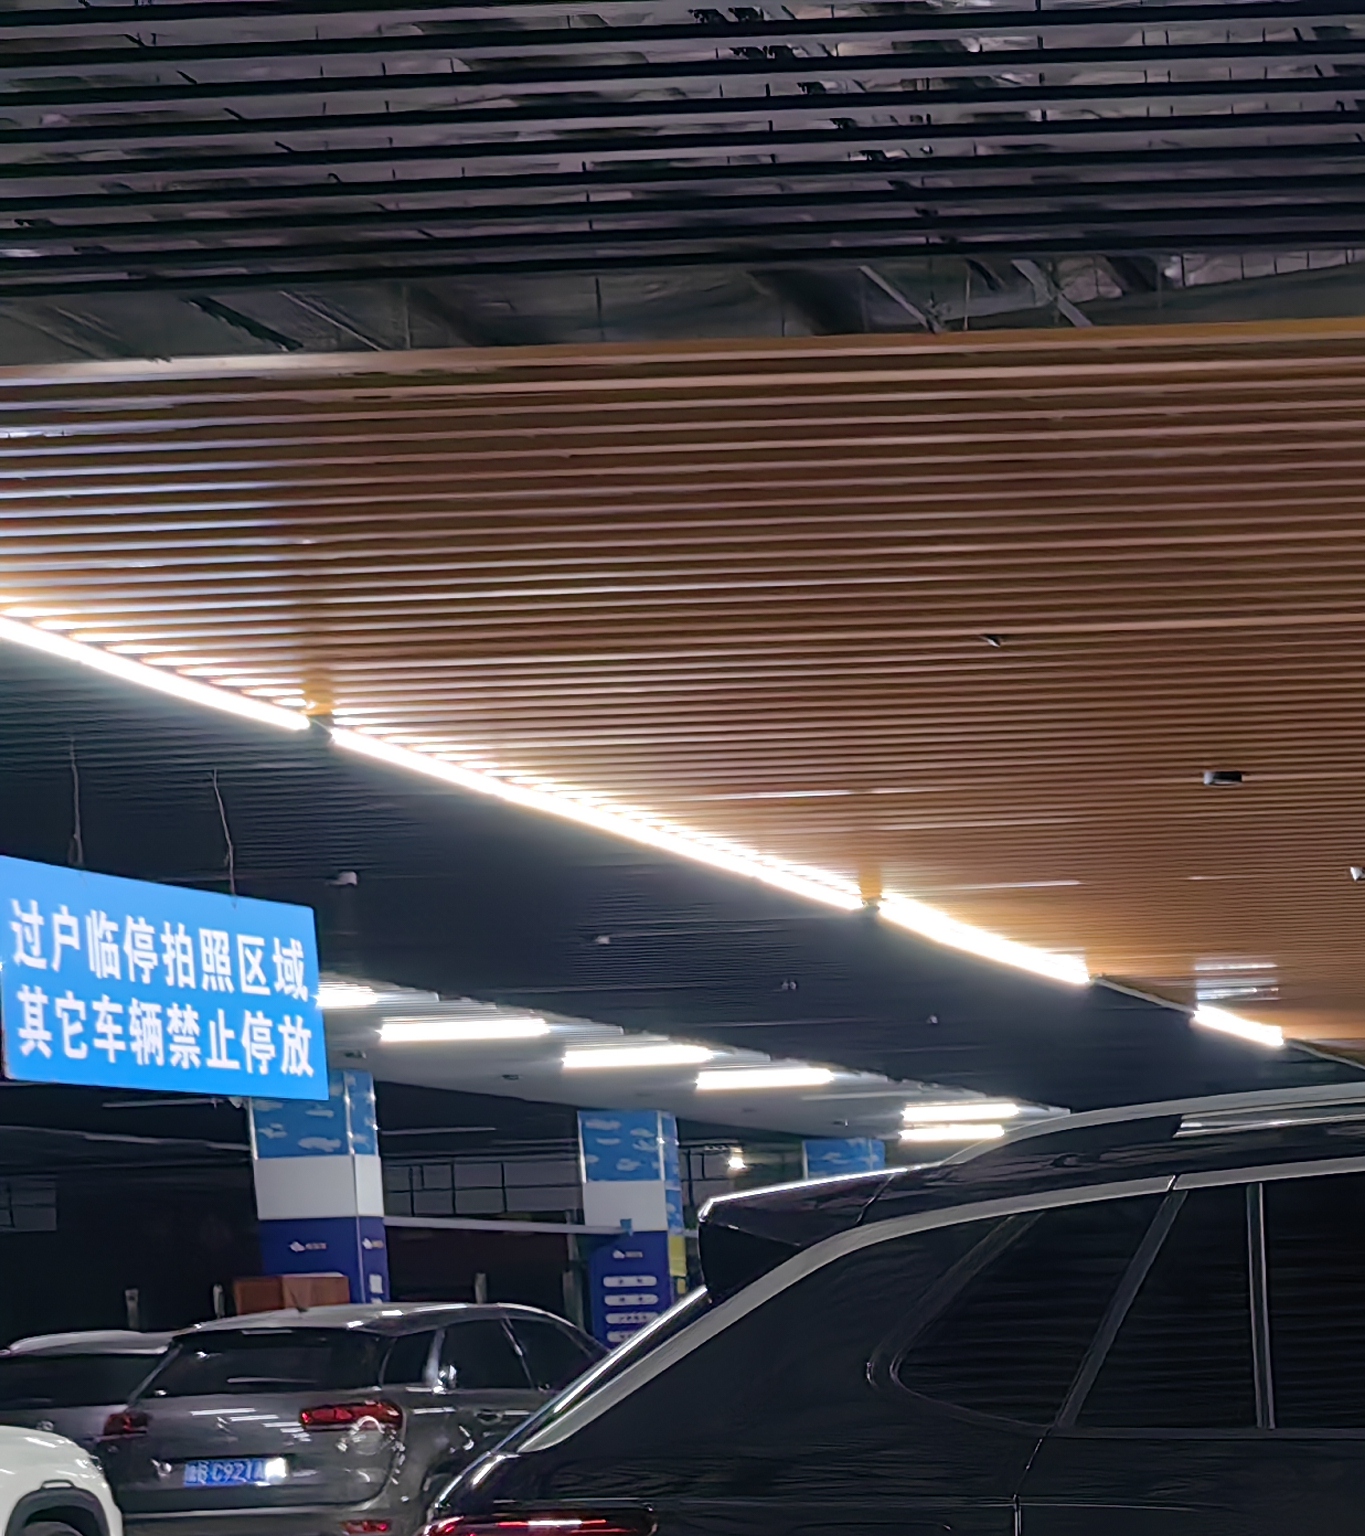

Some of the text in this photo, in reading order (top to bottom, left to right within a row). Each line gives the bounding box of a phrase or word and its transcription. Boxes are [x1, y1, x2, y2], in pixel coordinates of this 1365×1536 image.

[10, 898, 309, 1003] 过户临停拍照区域
[17, 983, 314, 1077] 其它车辆禁止停放
